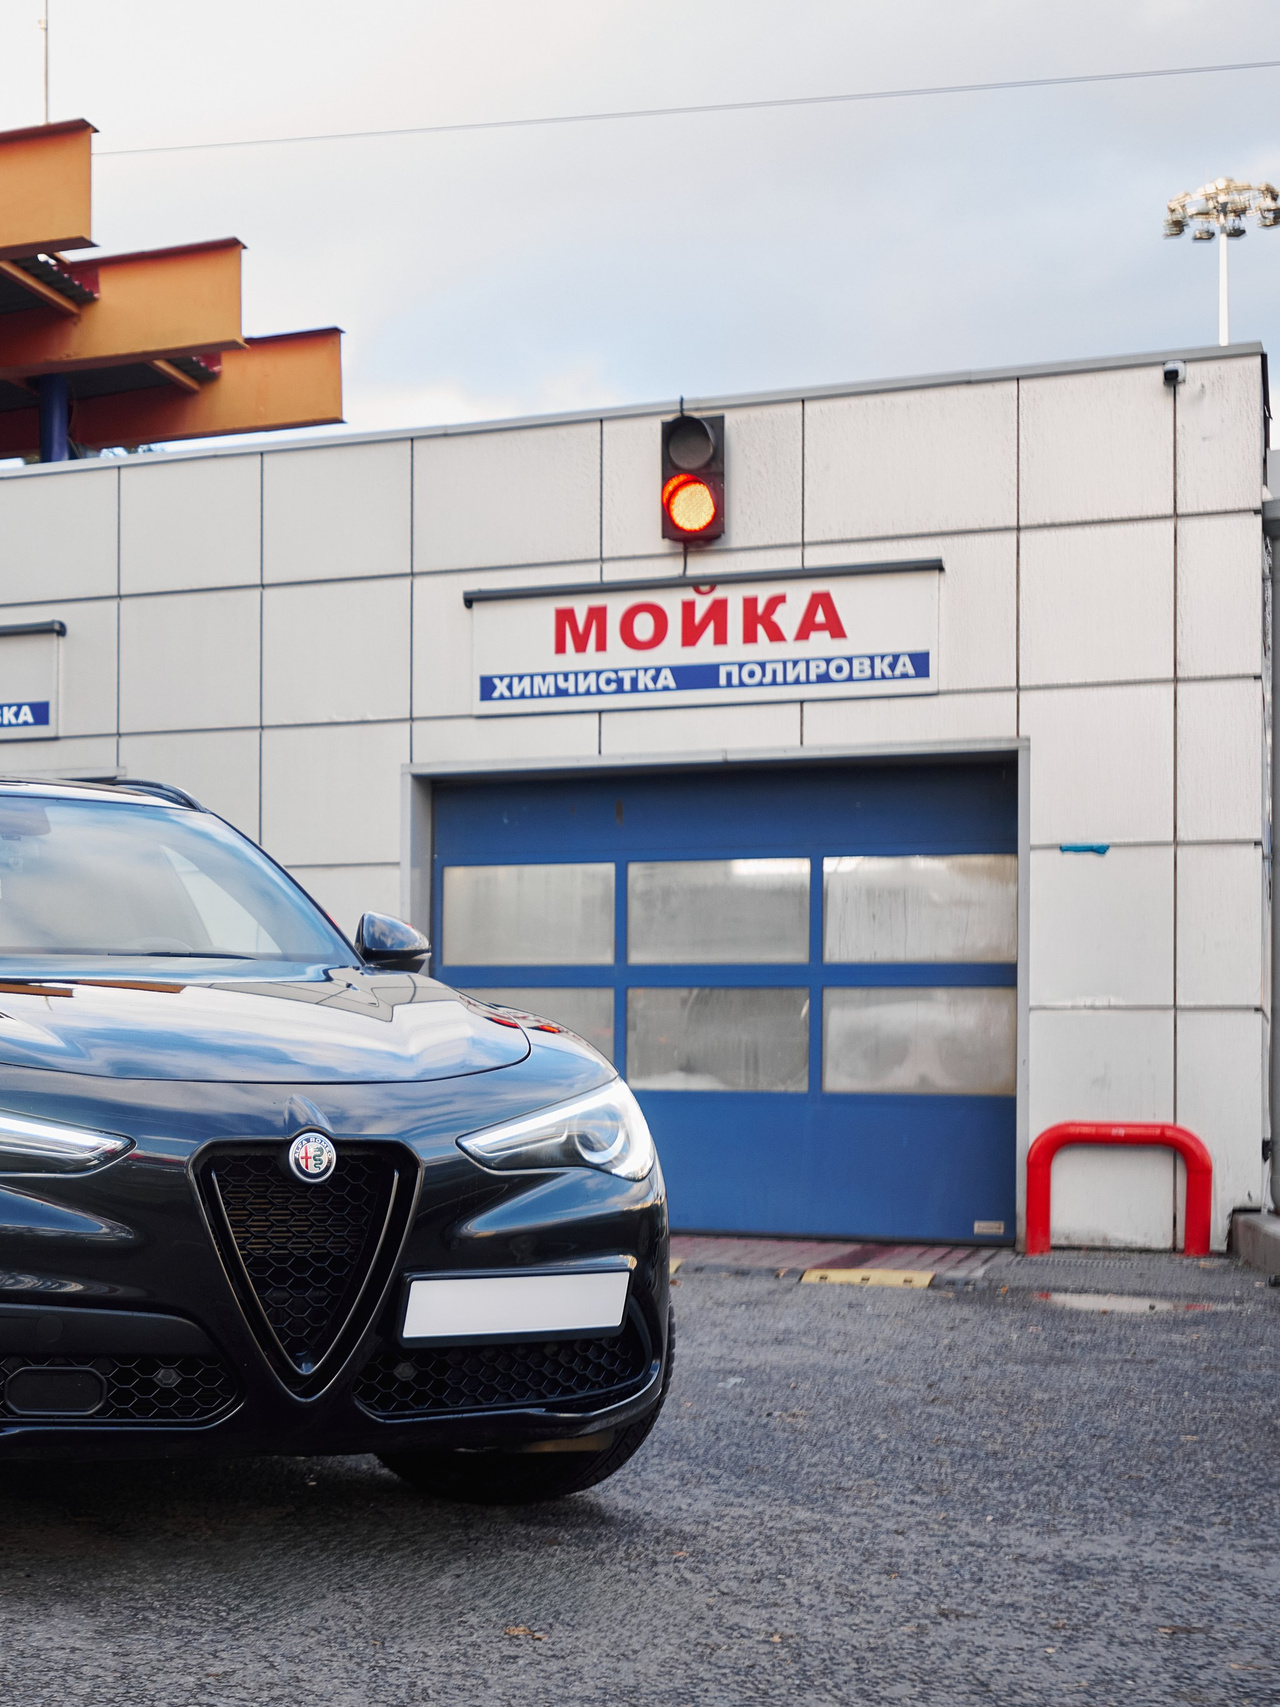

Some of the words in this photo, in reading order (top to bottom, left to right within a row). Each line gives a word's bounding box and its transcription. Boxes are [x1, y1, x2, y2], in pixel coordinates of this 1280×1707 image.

[553, 585, 848, 655] МОЙКА
[490, 667, 678, 699] ХИМЧИСТКА
[718, 653, 916, 687] ПОЛИРОВКА
[294, 1139, 308, 1158] ALFA
[309, 1137, 332, 1158] ROMEO
